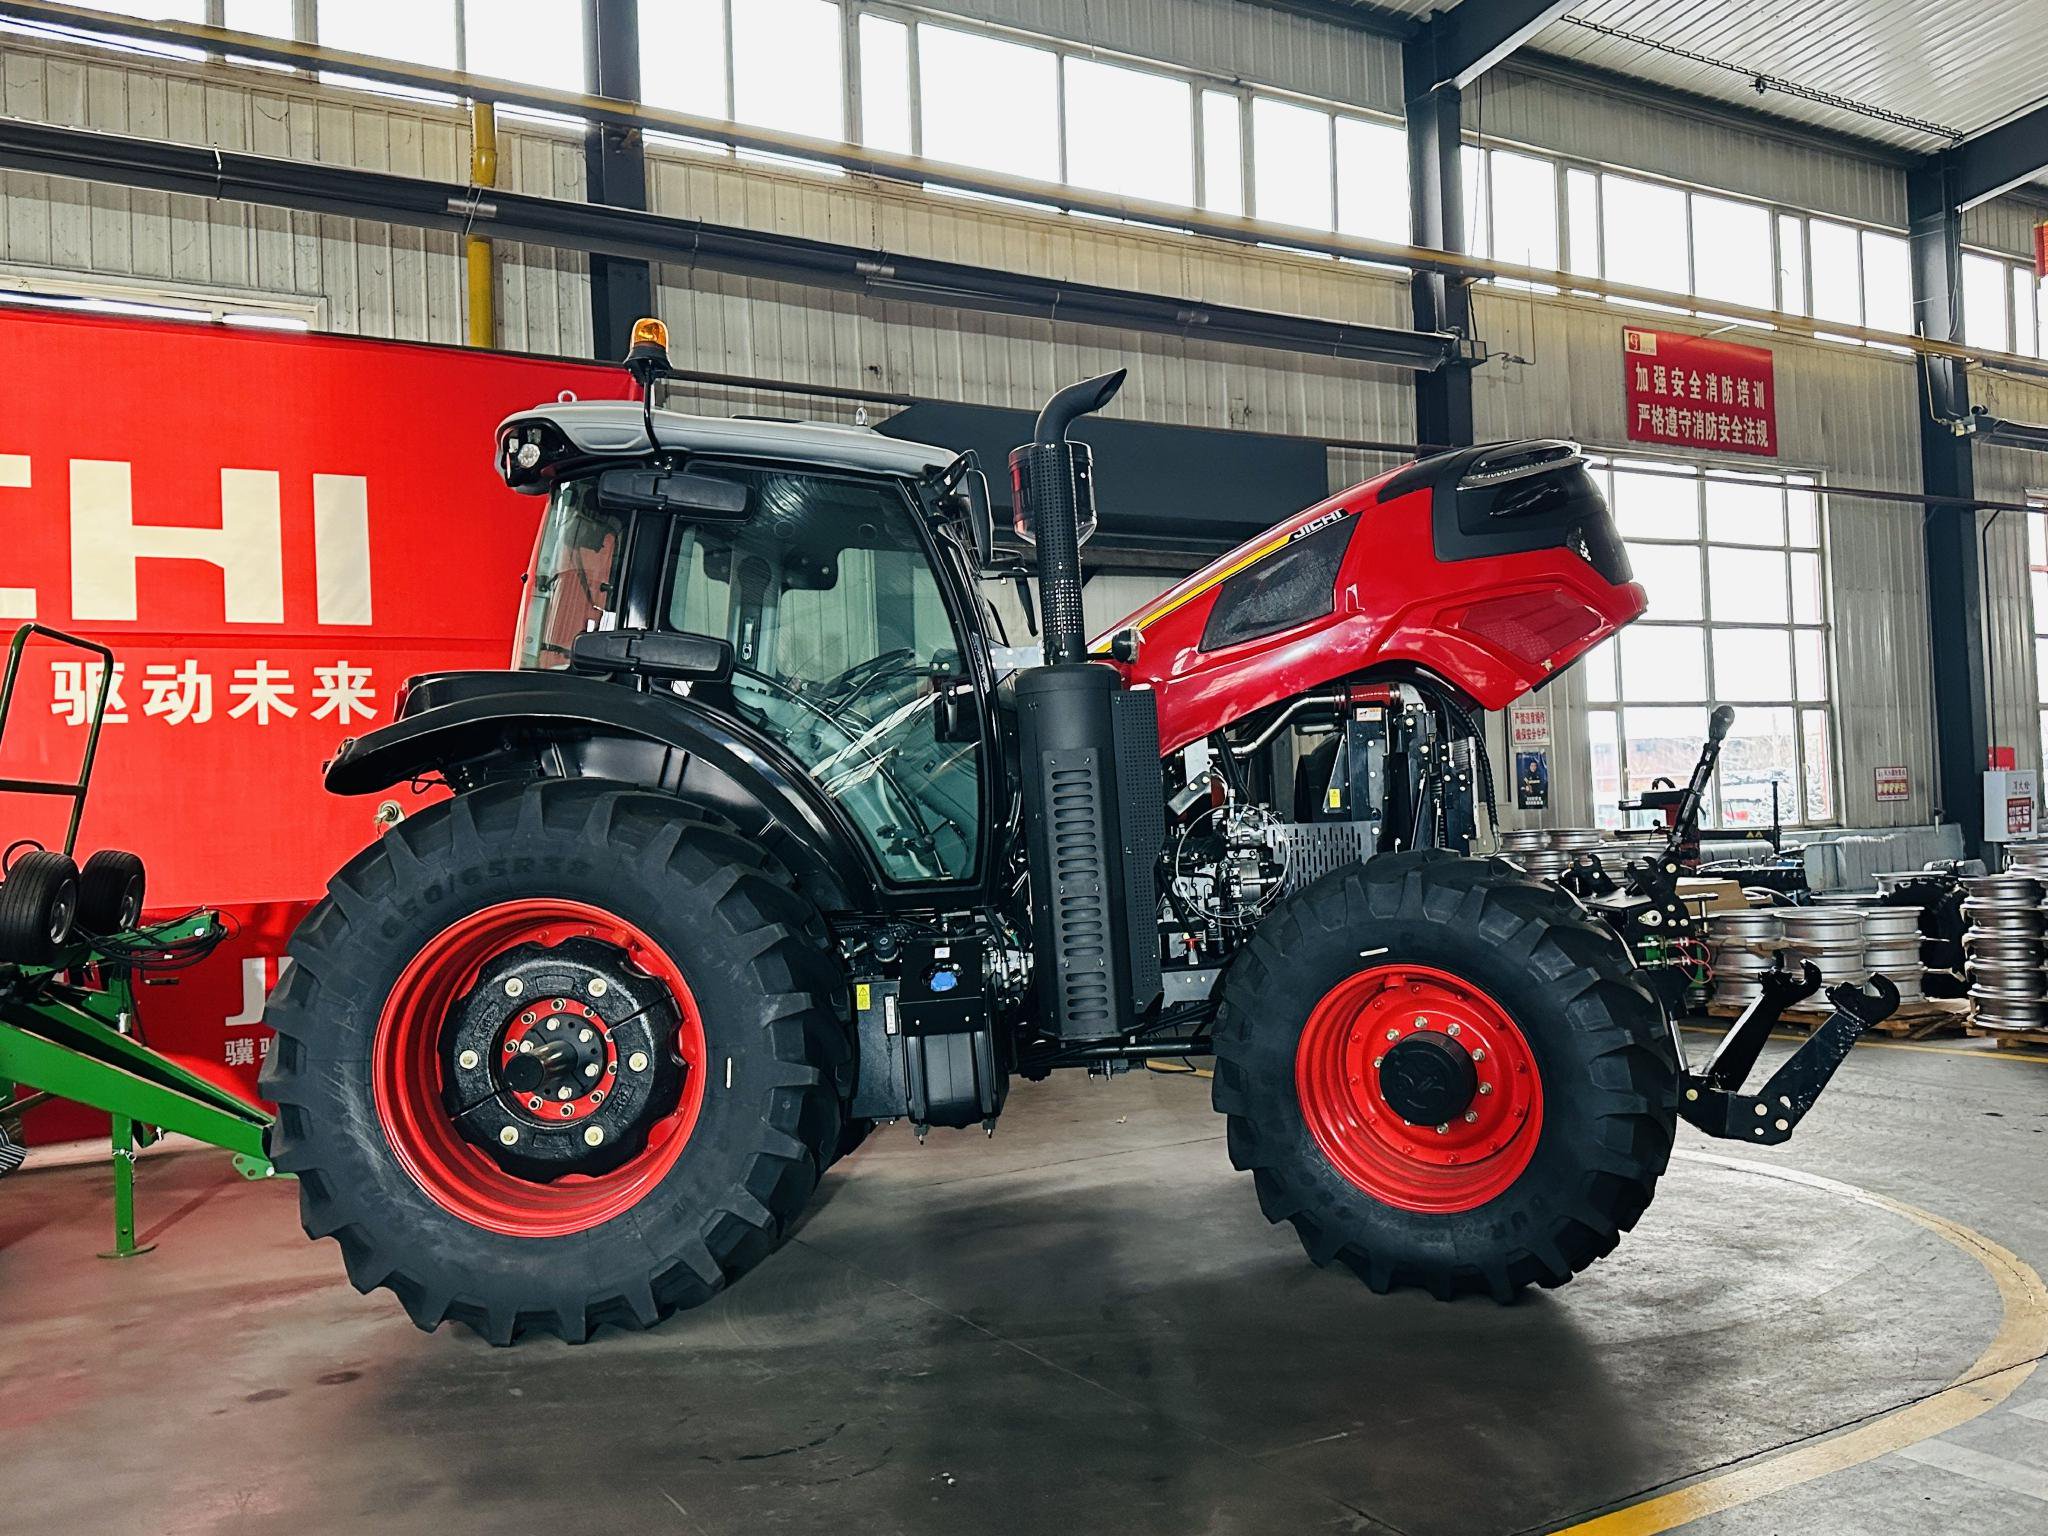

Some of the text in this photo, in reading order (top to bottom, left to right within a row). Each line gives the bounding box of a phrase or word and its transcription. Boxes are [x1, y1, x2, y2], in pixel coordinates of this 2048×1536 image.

[1635, 361, 1766, 410] 加强安全消防培训
[1637, 402, 1769, 448] 严格遵守消防安全法规
[0, 454, 373, 626] HI
[50, 658, 378, 726] 驱动未来
